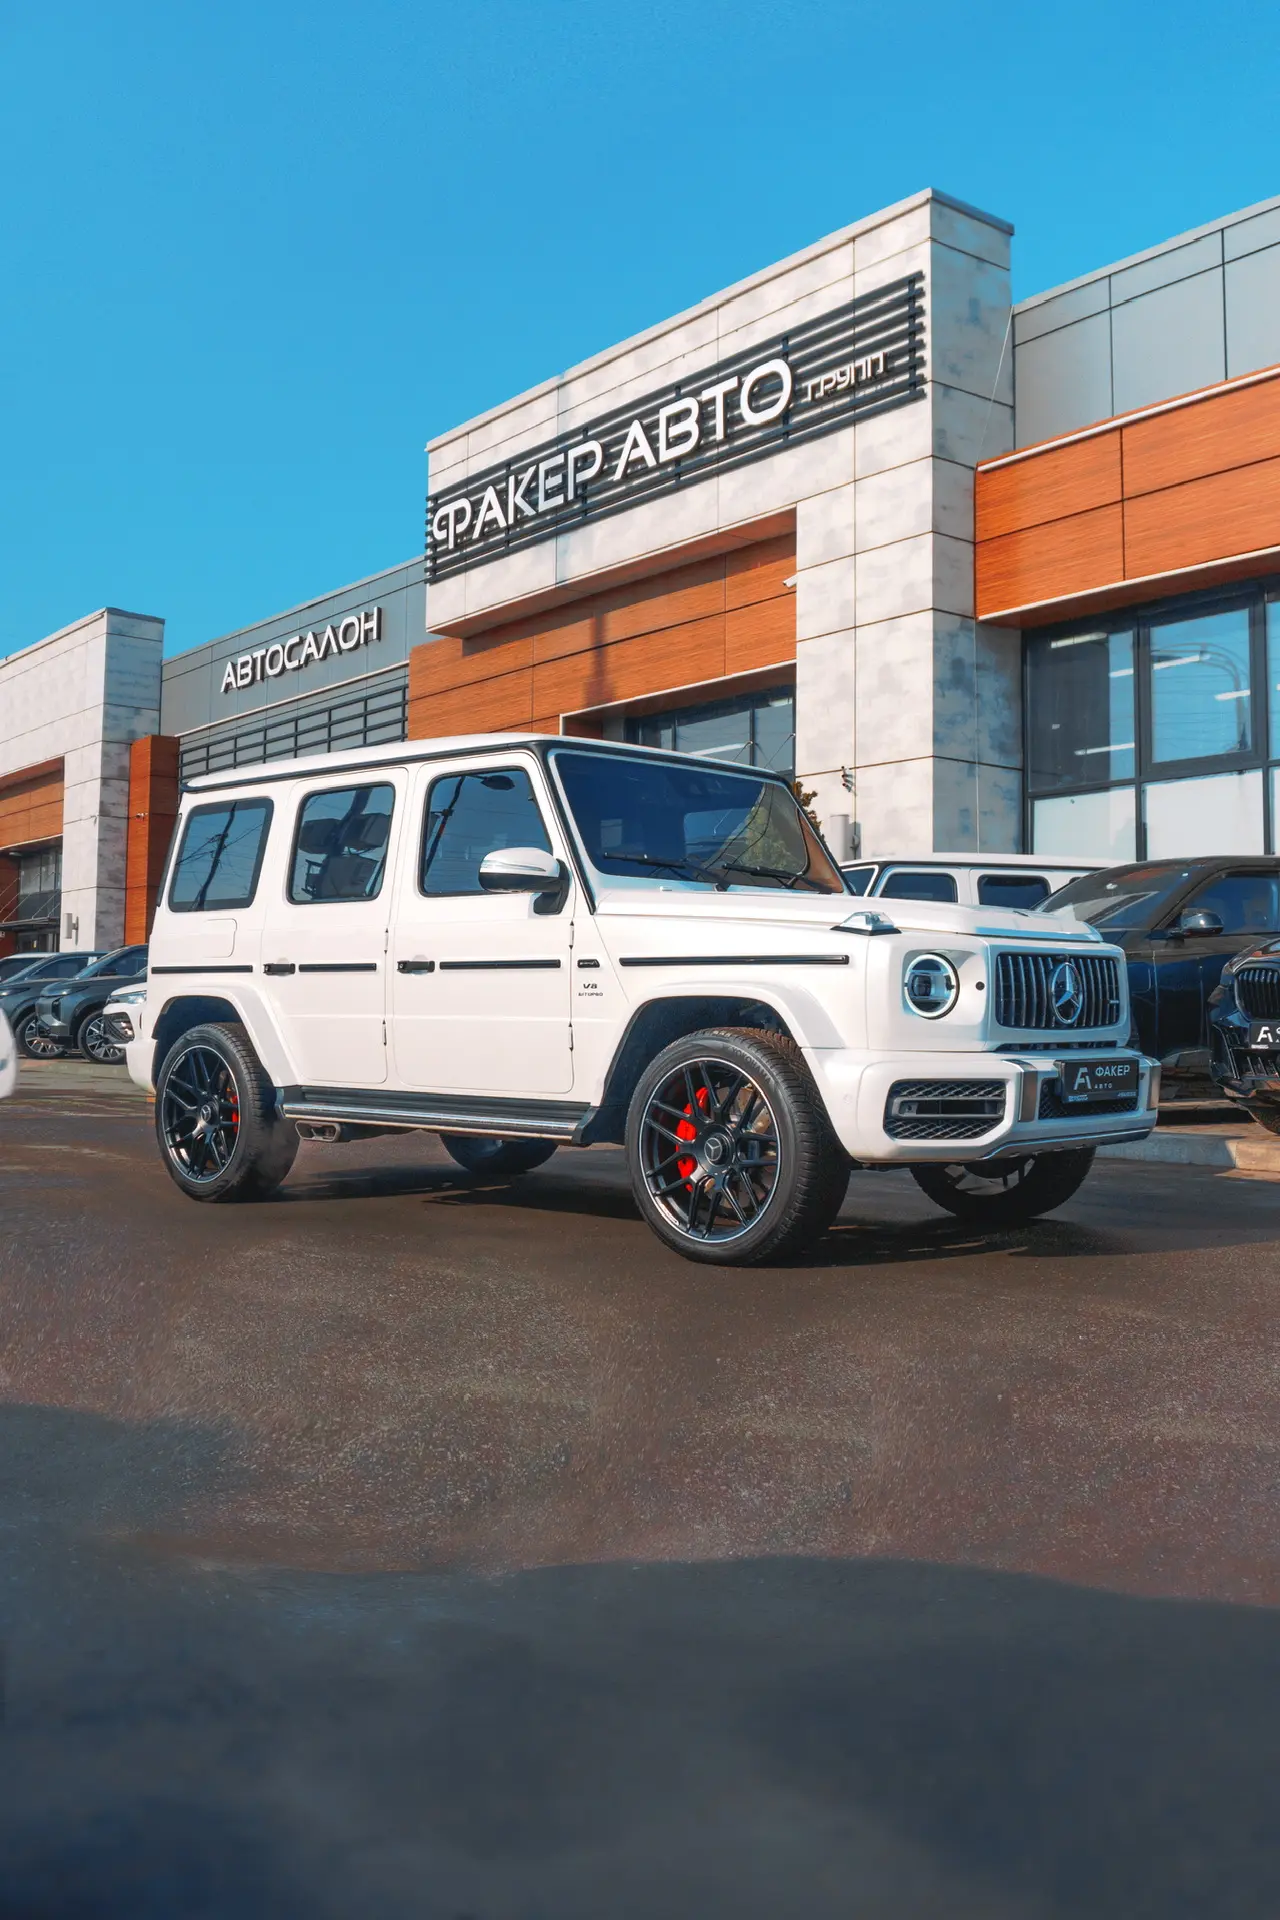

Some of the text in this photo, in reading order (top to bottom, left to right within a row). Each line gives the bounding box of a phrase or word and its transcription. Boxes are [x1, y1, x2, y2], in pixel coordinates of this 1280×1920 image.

[433, 351, 888, 549] ФАКЕР АВТО ГРУПП
[220, 606, 382, 693] АВТОСАЛОН
[1095, 1064, 1131, 1077] ФАКЕР
